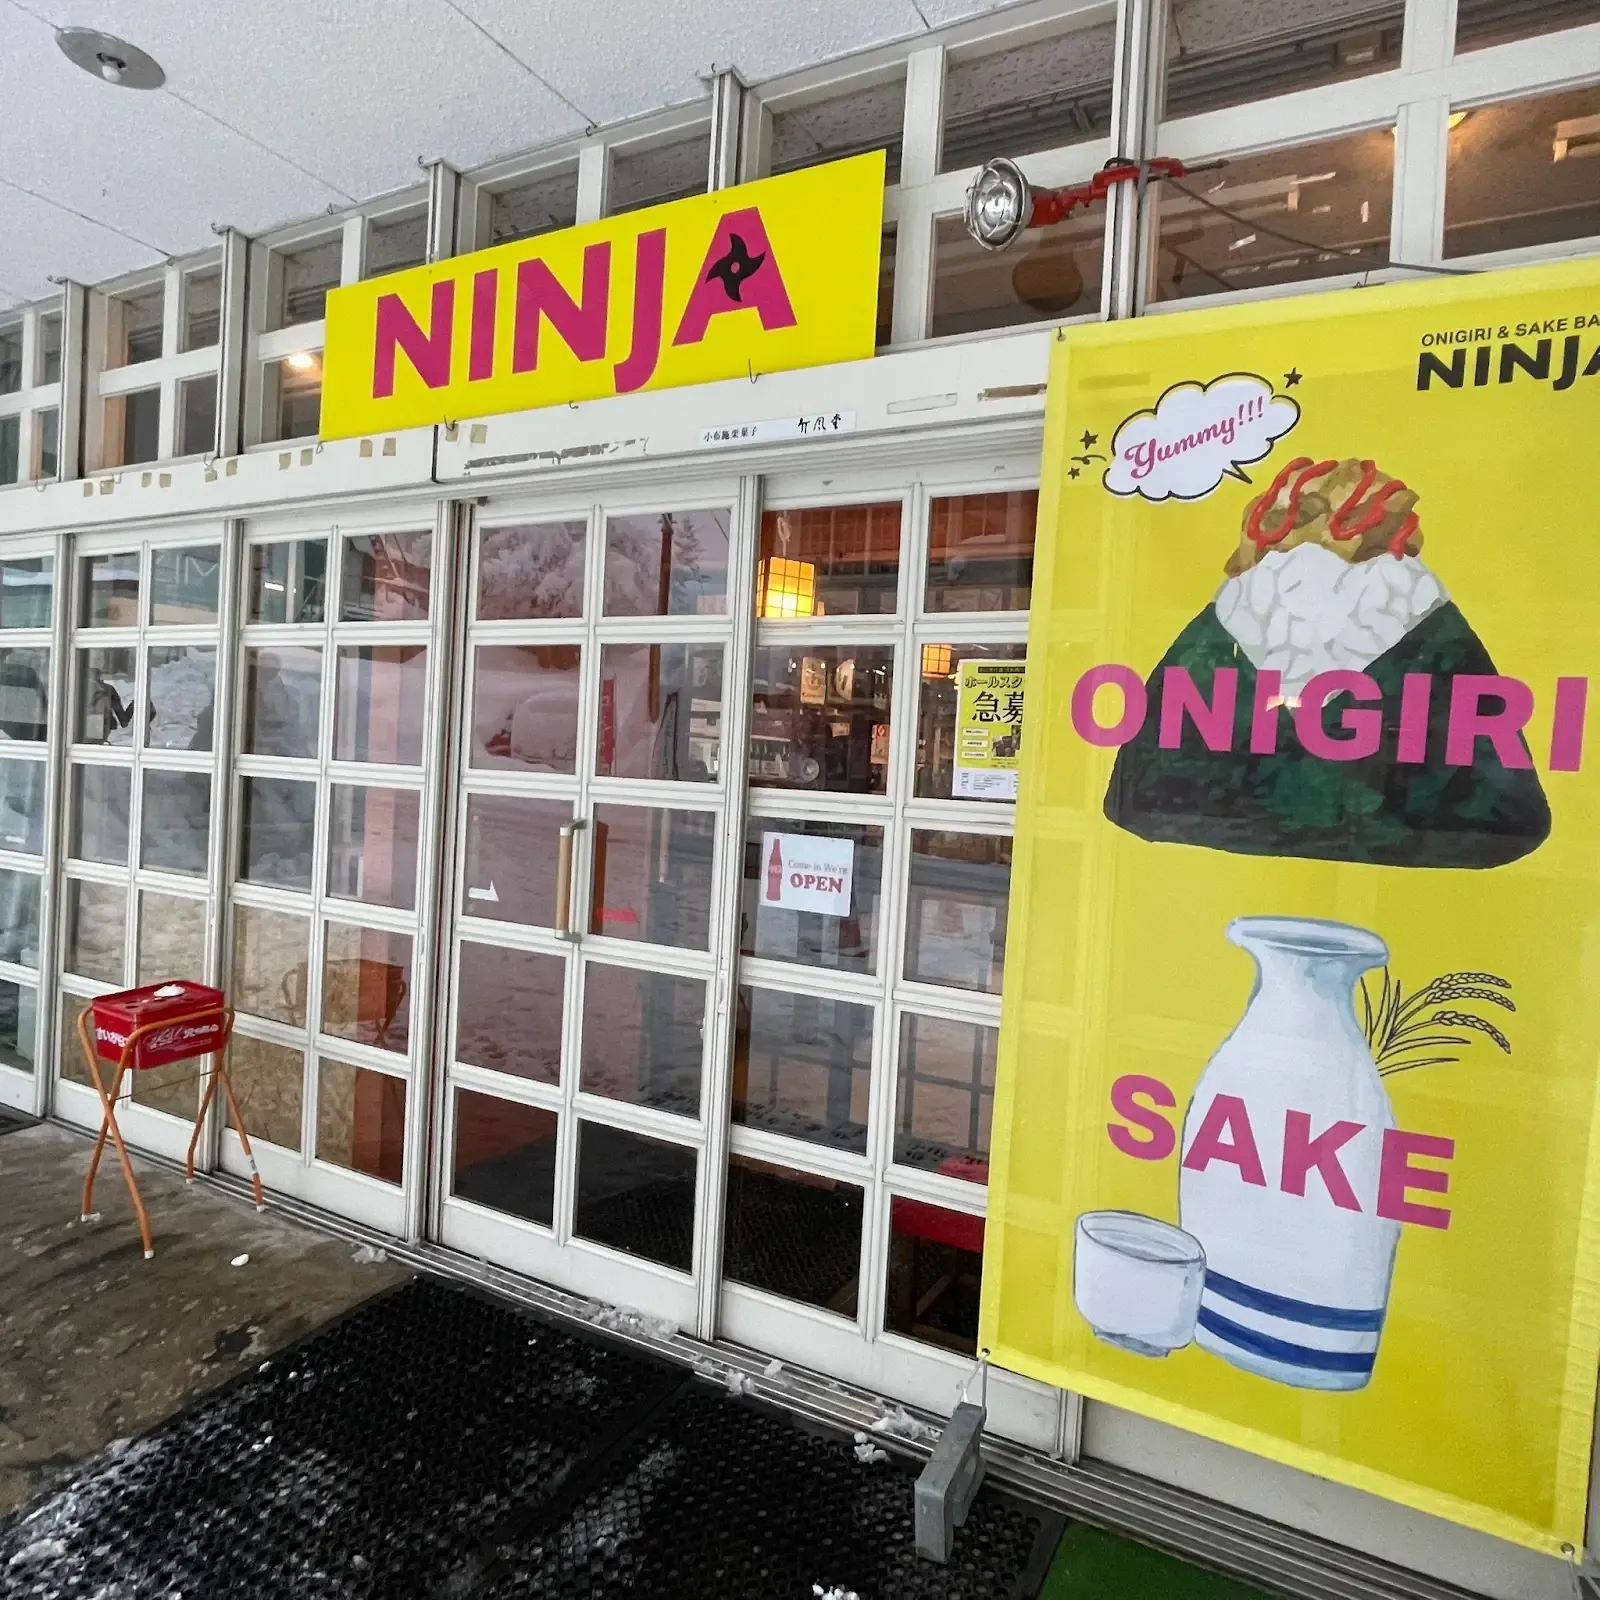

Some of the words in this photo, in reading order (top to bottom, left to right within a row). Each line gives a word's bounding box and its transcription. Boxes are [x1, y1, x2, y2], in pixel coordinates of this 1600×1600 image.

[372, 206, 798, 399] NINJA
[1421, 327, 1492, 347] ONIGIRI
[1497, 325, 1509, 339] &
[1515, 318, 1568, 337] SAKE
[1124, 396, 1263, 479] Yummy!!!
[1070, 663, 1588, 772] ONIGIRI
[788, 859, 811, 871] Come
[813, 863, 821, 872] in
[790, 872, 844, 894] OPEN
[1107, 1074, 1455, 1230] SAKE
